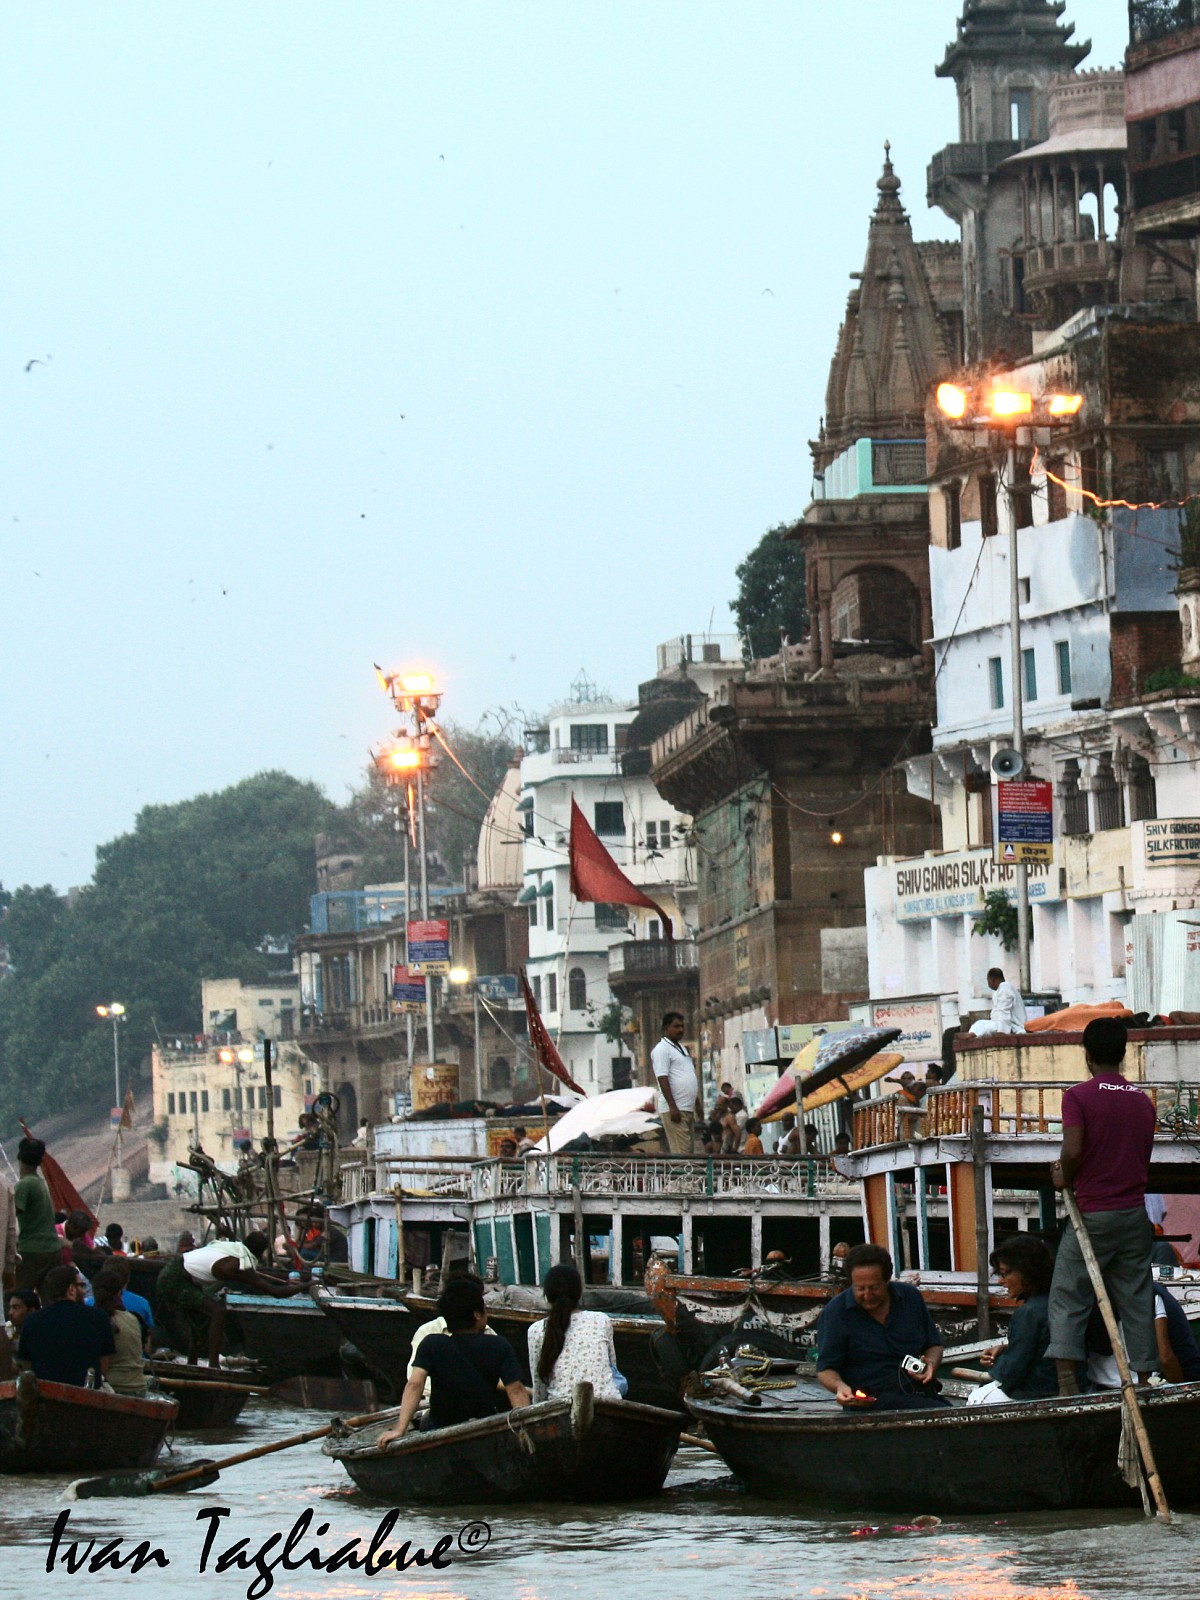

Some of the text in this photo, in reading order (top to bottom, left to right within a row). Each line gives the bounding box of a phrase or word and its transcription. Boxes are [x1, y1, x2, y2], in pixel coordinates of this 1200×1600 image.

[1146, 822, 1200, 836] SHIV GANGA
[897, 869, 922, 896] SHIV
[923, 862, 960, 892] GANGA
[961, 857, 988, 887] SILK
